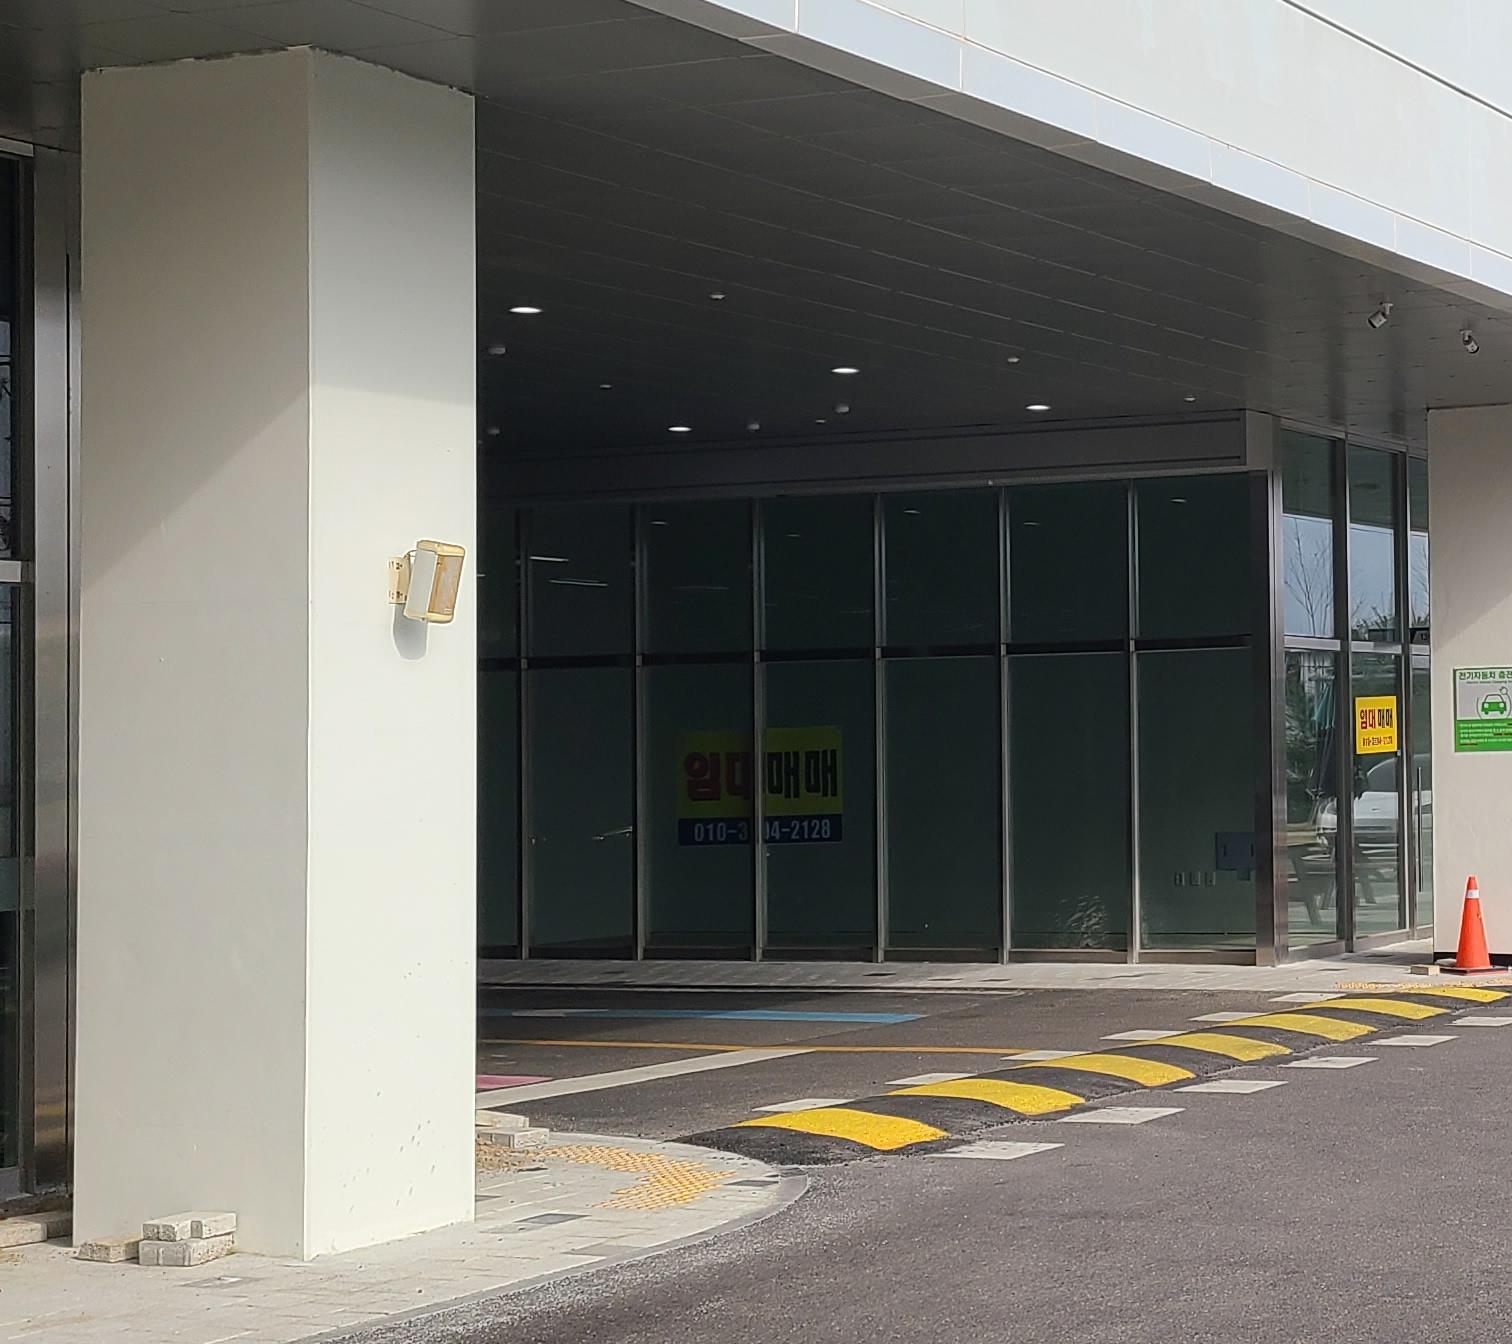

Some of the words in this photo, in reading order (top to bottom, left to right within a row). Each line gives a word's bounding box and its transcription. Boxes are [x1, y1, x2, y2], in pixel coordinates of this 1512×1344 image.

[1360, 708, 1376, 730] 임대
[1378, 709, 1393, 728] 매매
[767, 749, 838, 799] 매매
[694, 819, 831, 842] 010-34-2128
